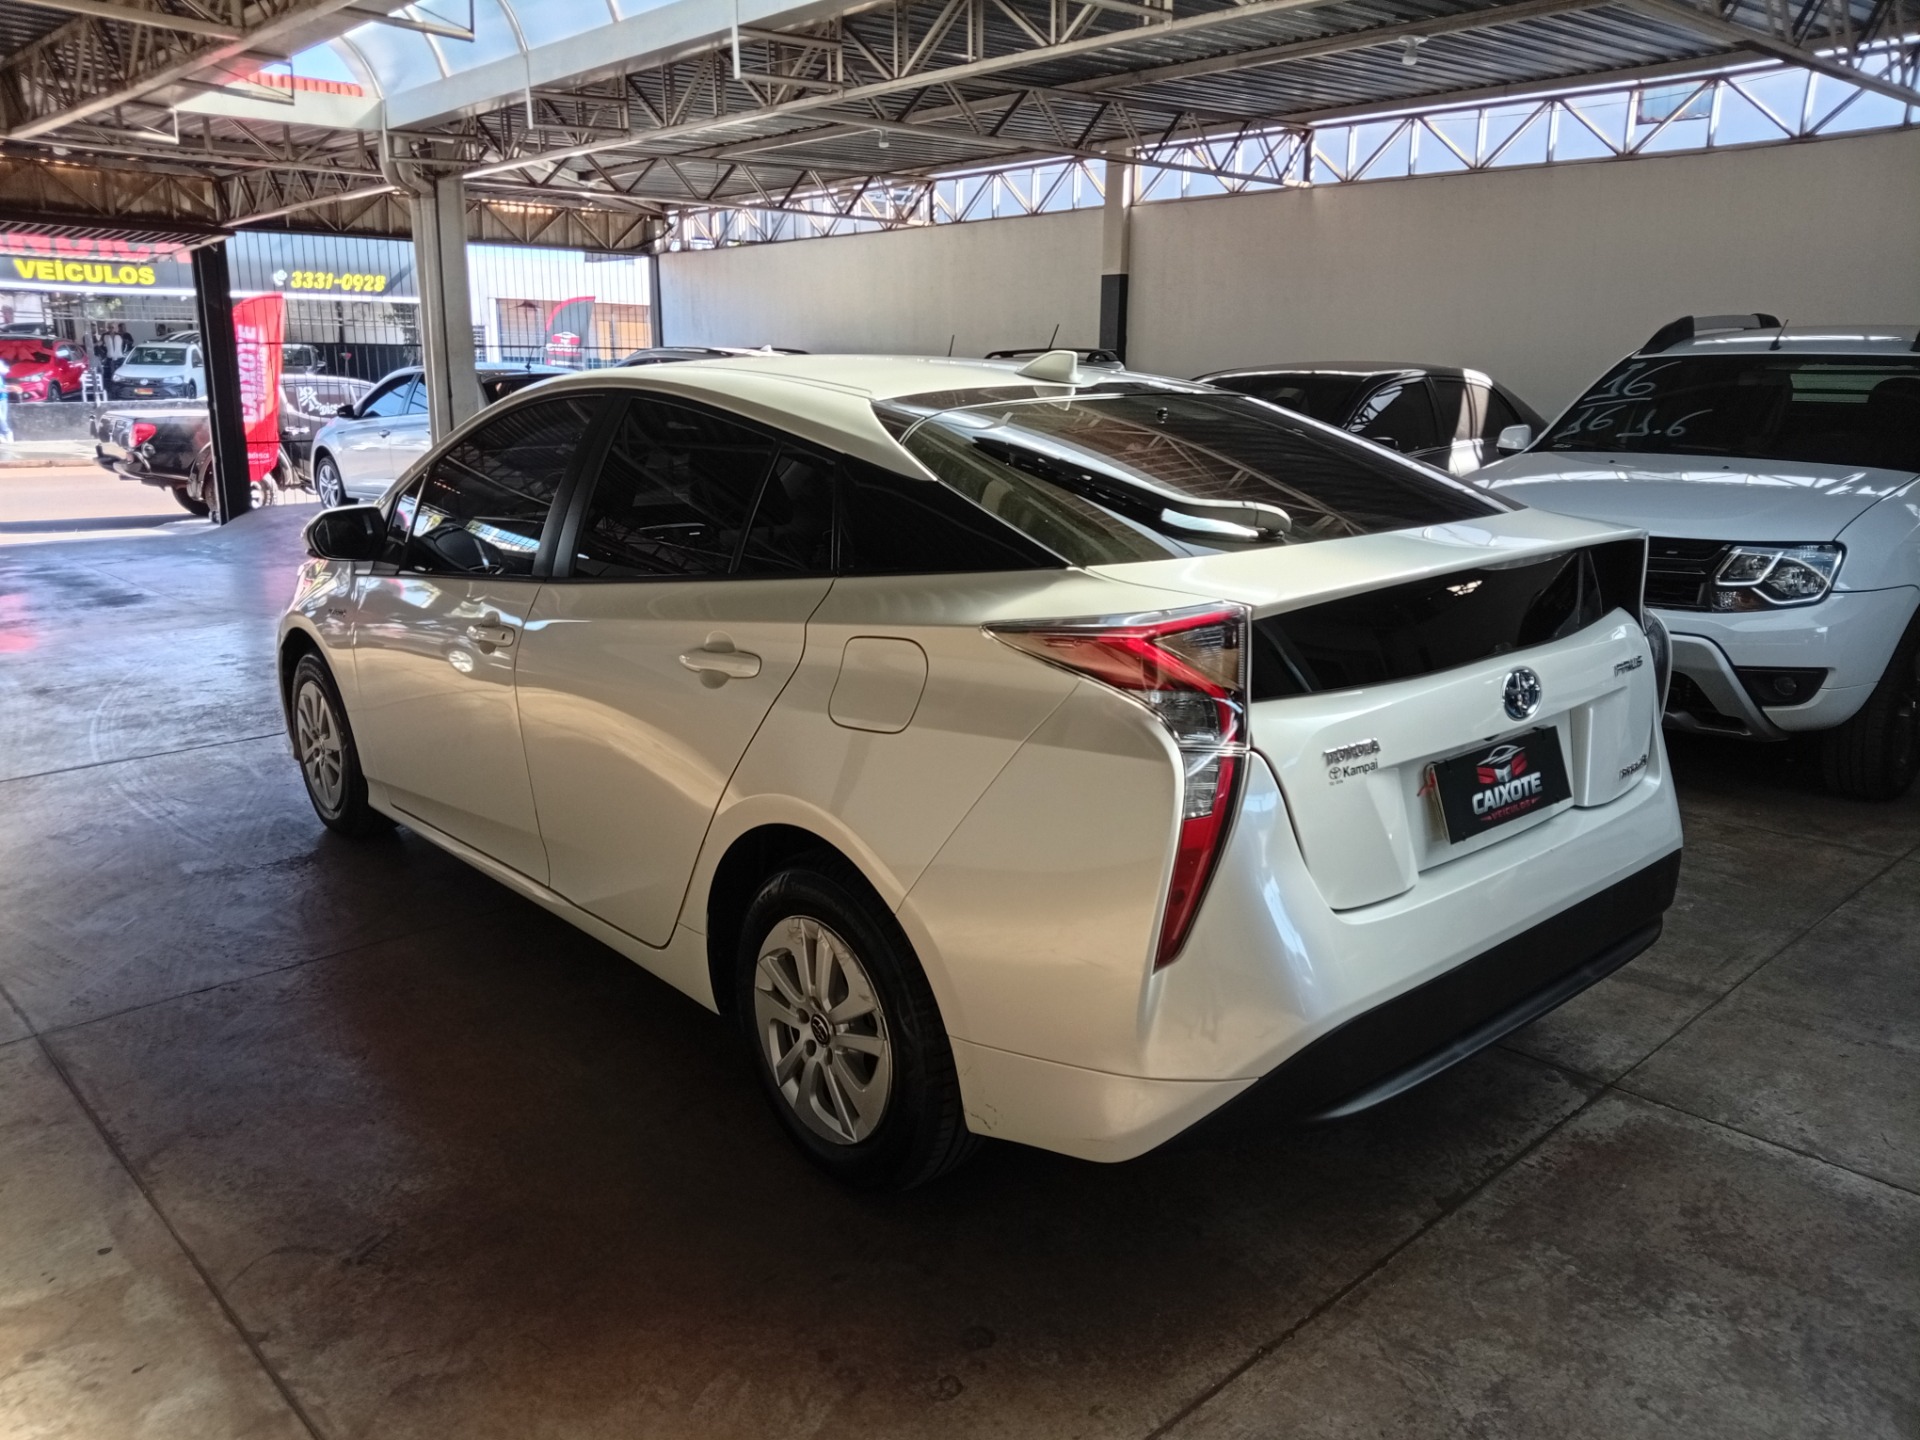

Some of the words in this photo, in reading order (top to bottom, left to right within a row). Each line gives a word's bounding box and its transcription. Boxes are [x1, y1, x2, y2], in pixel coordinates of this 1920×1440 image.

[13, 258, 156, 285] VEÍCULOS
[291, 271, 386, 292] 3331-0928
[237, 325, 258, 423] CAIXOTE
[1323, 737, 1381, 767] TOYOTA
[1343, 758, 1378, 778] Kampai
[1472, 771, 1543, 815] CAIXOTE
